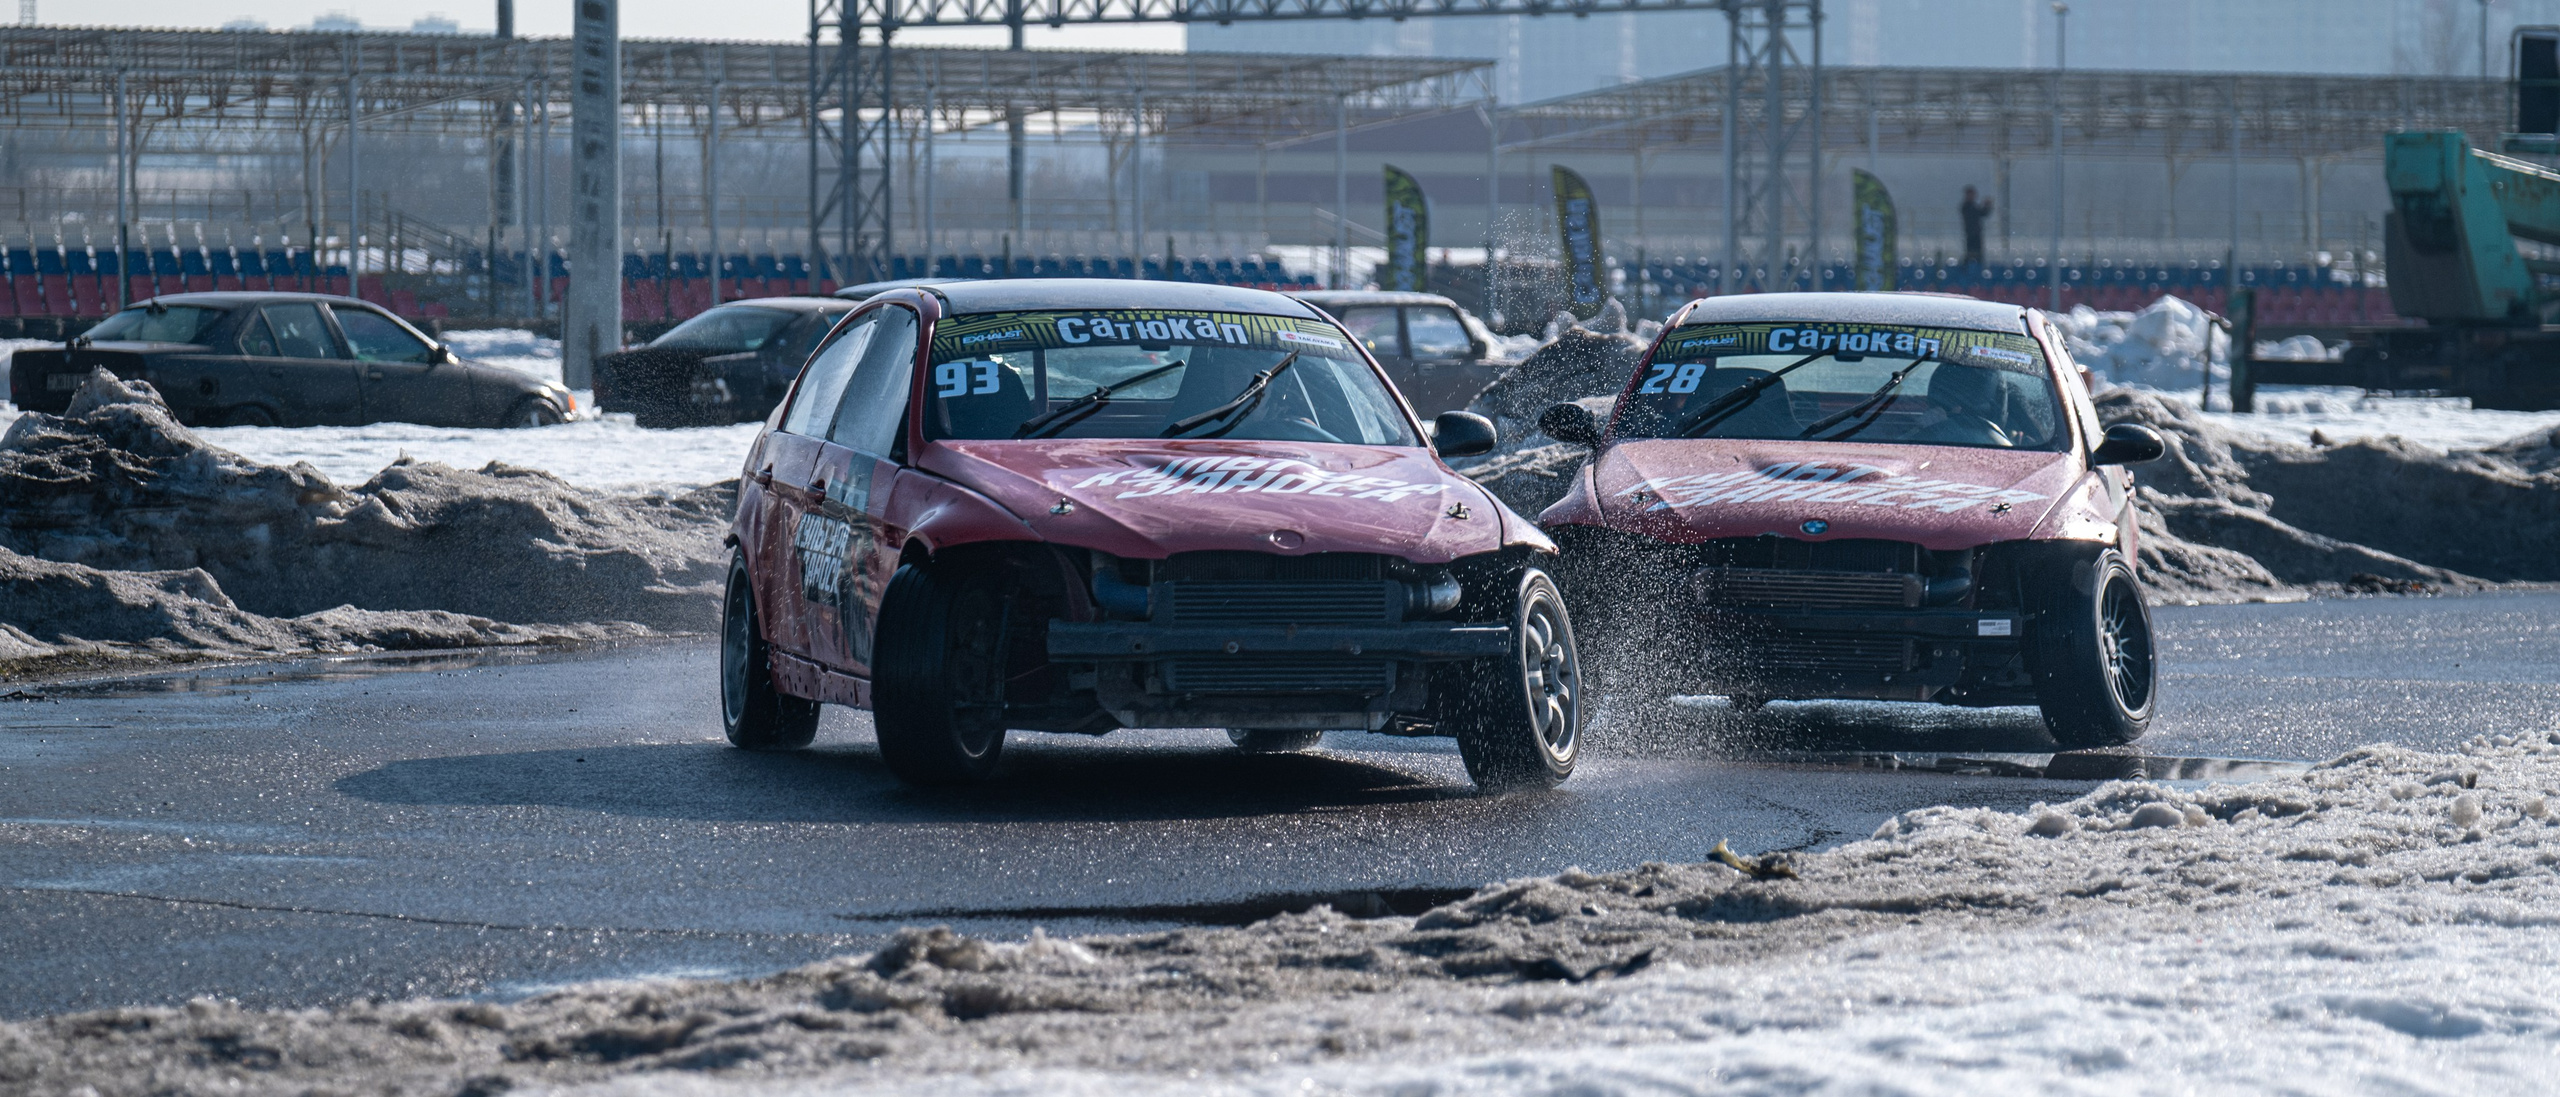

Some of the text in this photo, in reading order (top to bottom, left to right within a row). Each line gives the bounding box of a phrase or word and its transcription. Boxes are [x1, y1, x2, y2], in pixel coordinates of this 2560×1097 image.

[962, 329, 1023, 344] EXHAUST
[935, 360, 1000, 398] 93
[1640, 363, 1707, 394] 28
